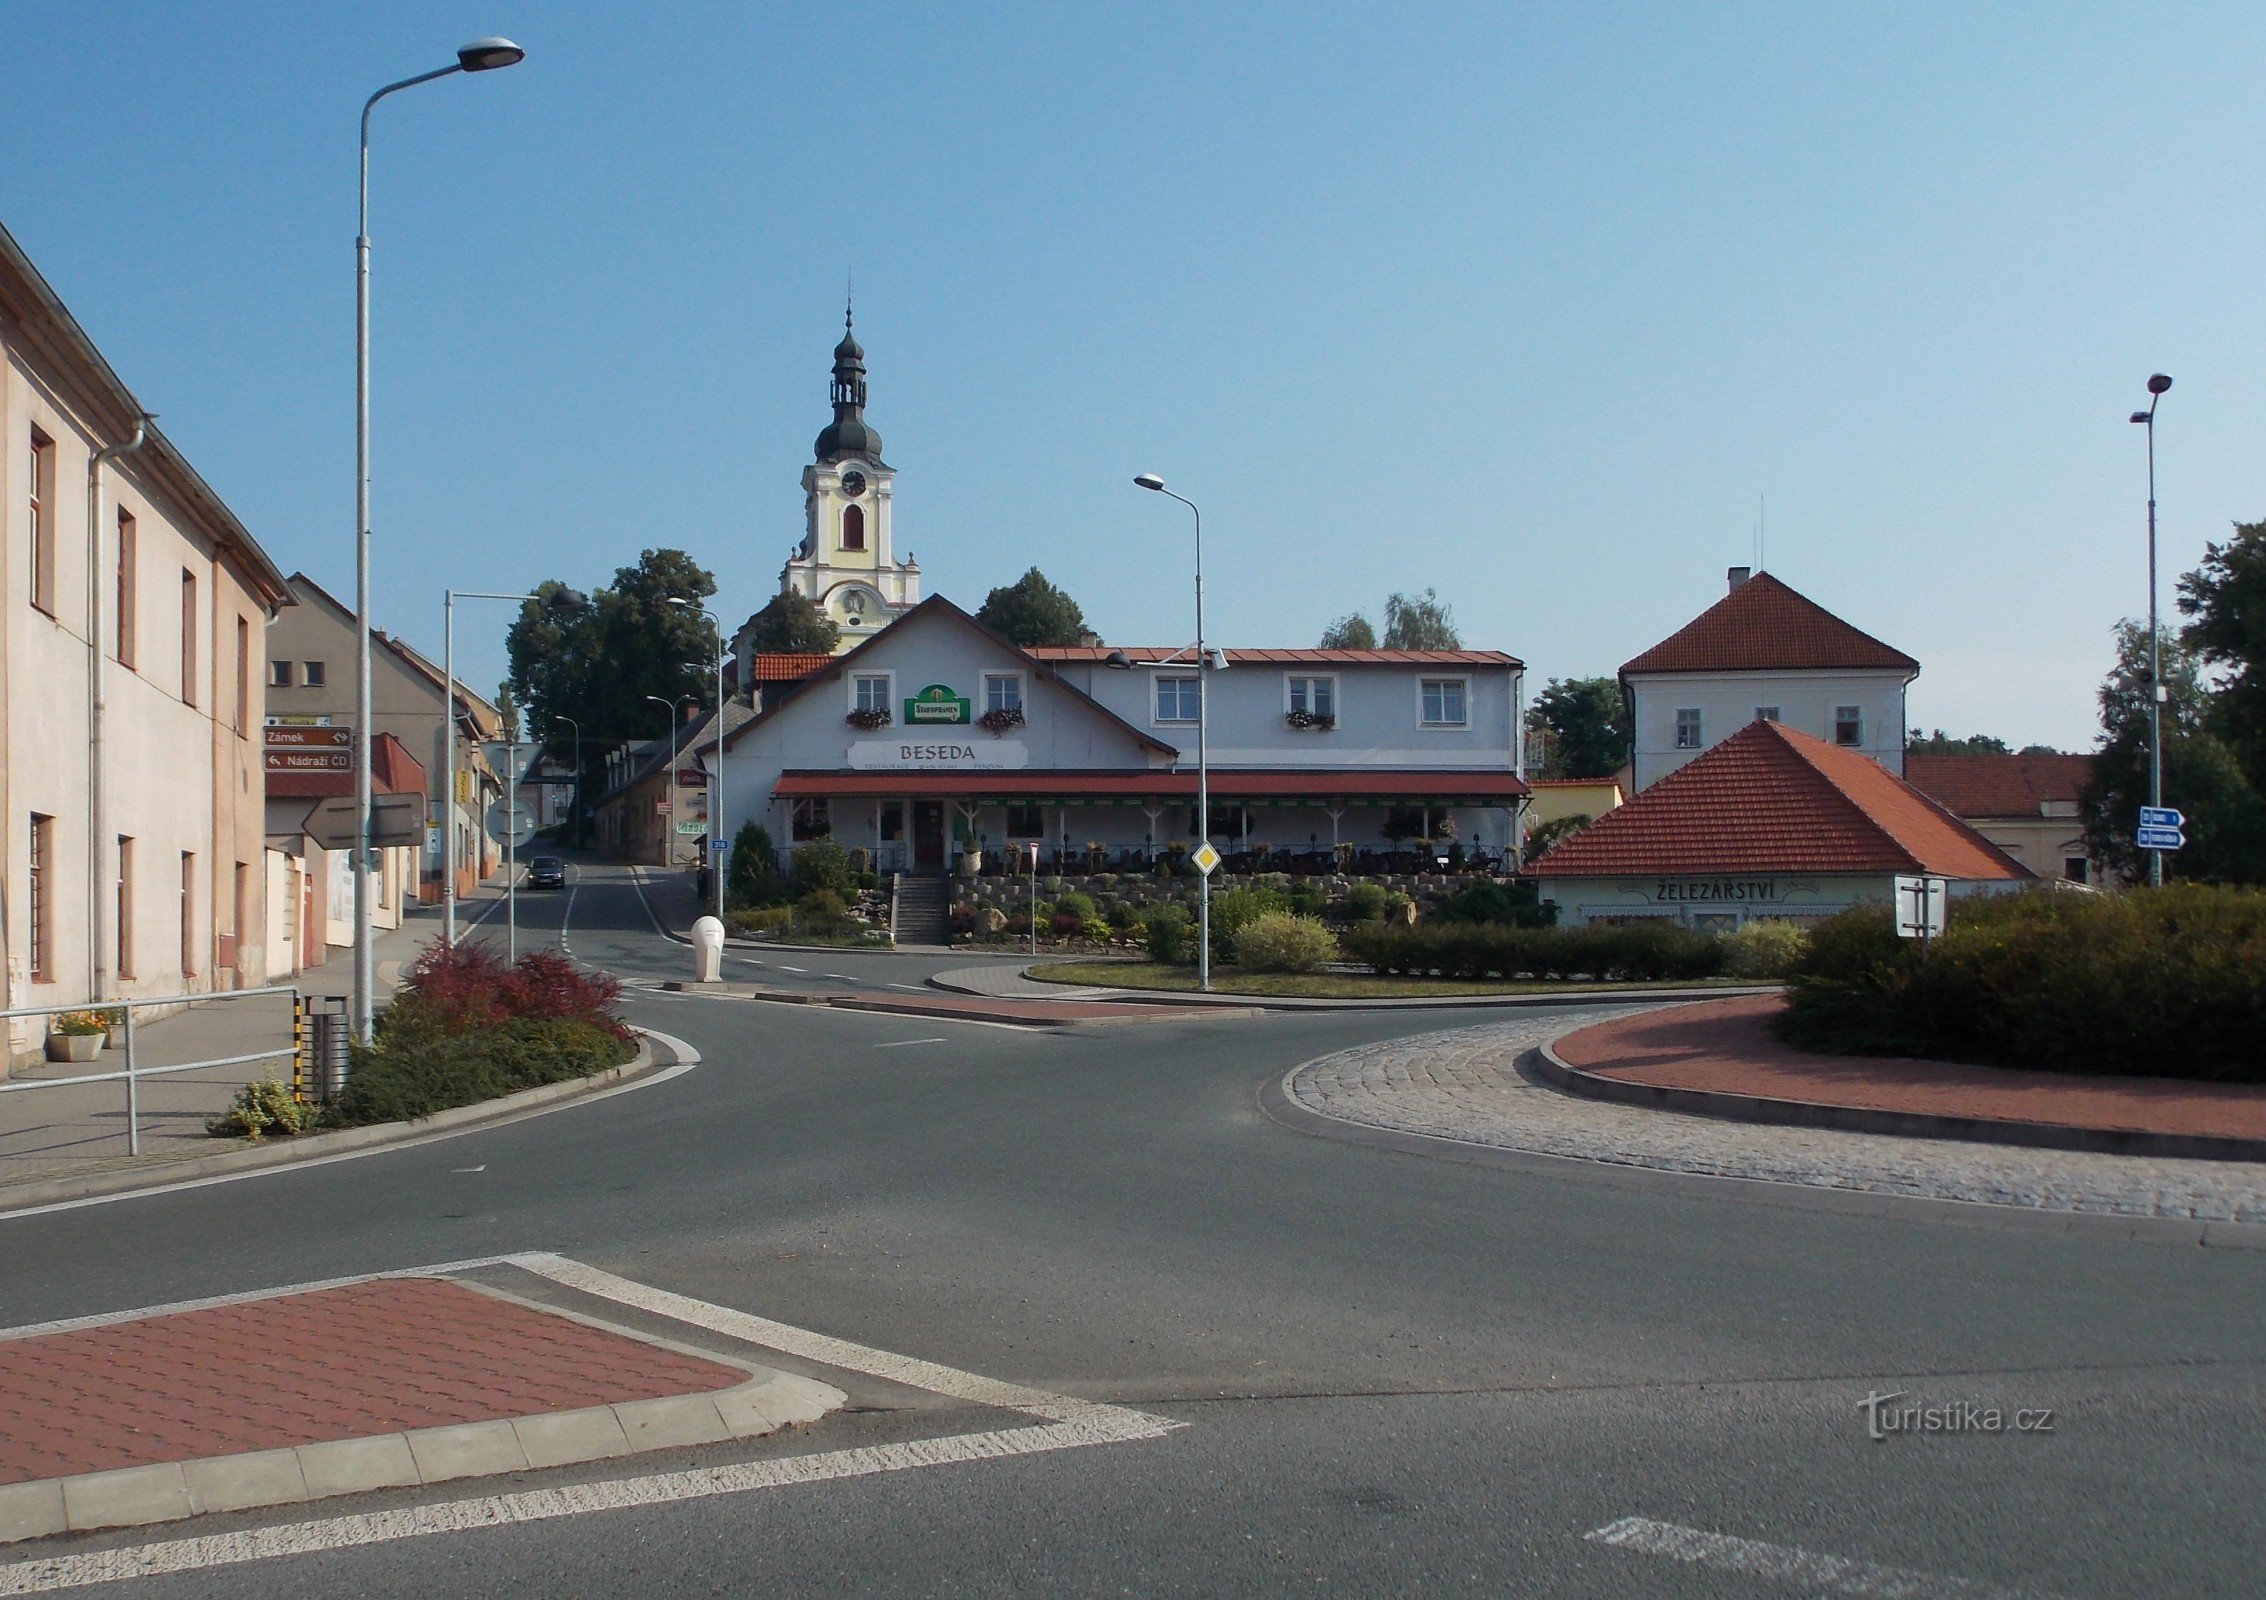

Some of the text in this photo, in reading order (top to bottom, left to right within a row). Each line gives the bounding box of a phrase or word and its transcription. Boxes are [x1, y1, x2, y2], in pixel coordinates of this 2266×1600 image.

[267, 731, 304, 743] Zámek
[287, 753, 347, 766] Nádraží ČD
[900, 745, 976, 760] BESEDA
[1656, 877, 1774, 900] ŽELEZÁŘSTVÍ
